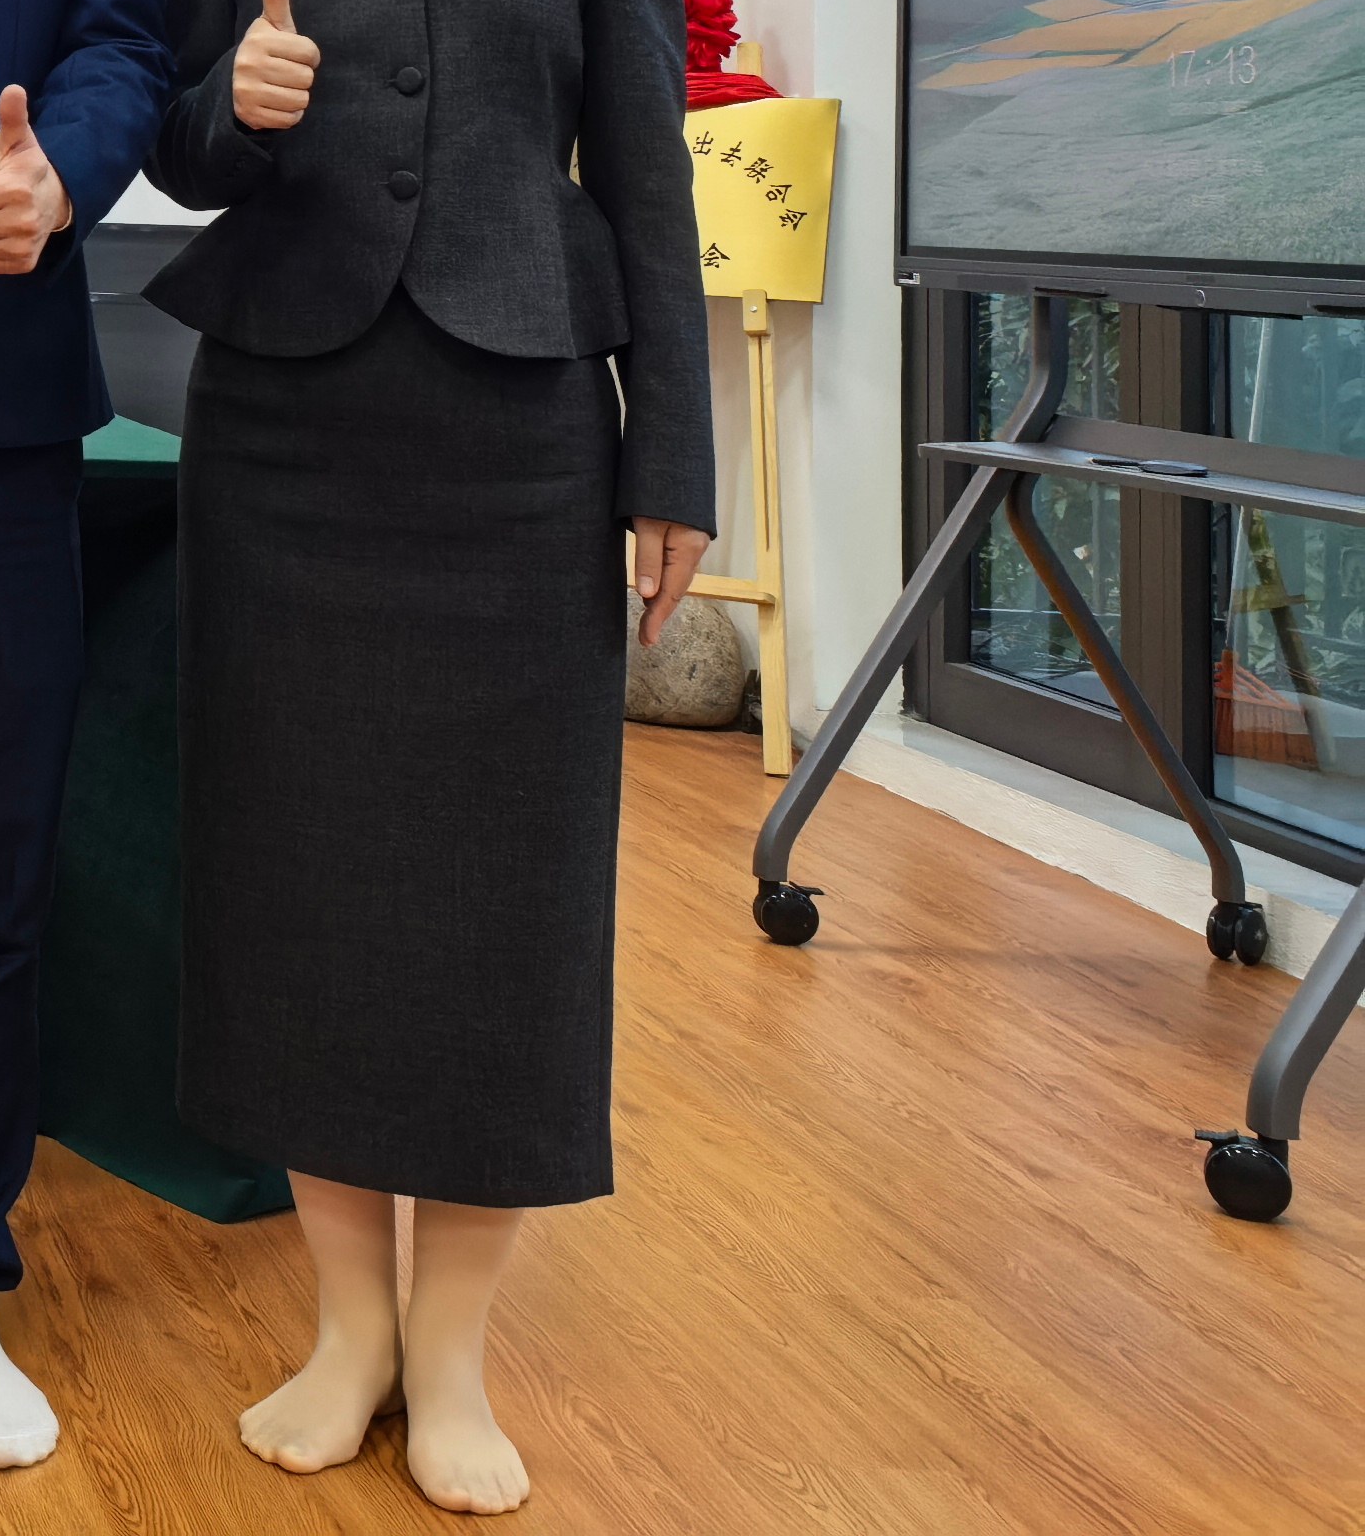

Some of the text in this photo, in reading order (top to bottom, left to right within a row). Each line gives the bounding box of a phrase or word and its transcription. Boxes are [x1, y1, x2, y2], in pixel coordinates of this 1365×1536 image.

[692, 131, 808, 231] 出去联合会
[700, 243, 731, 269] 会
